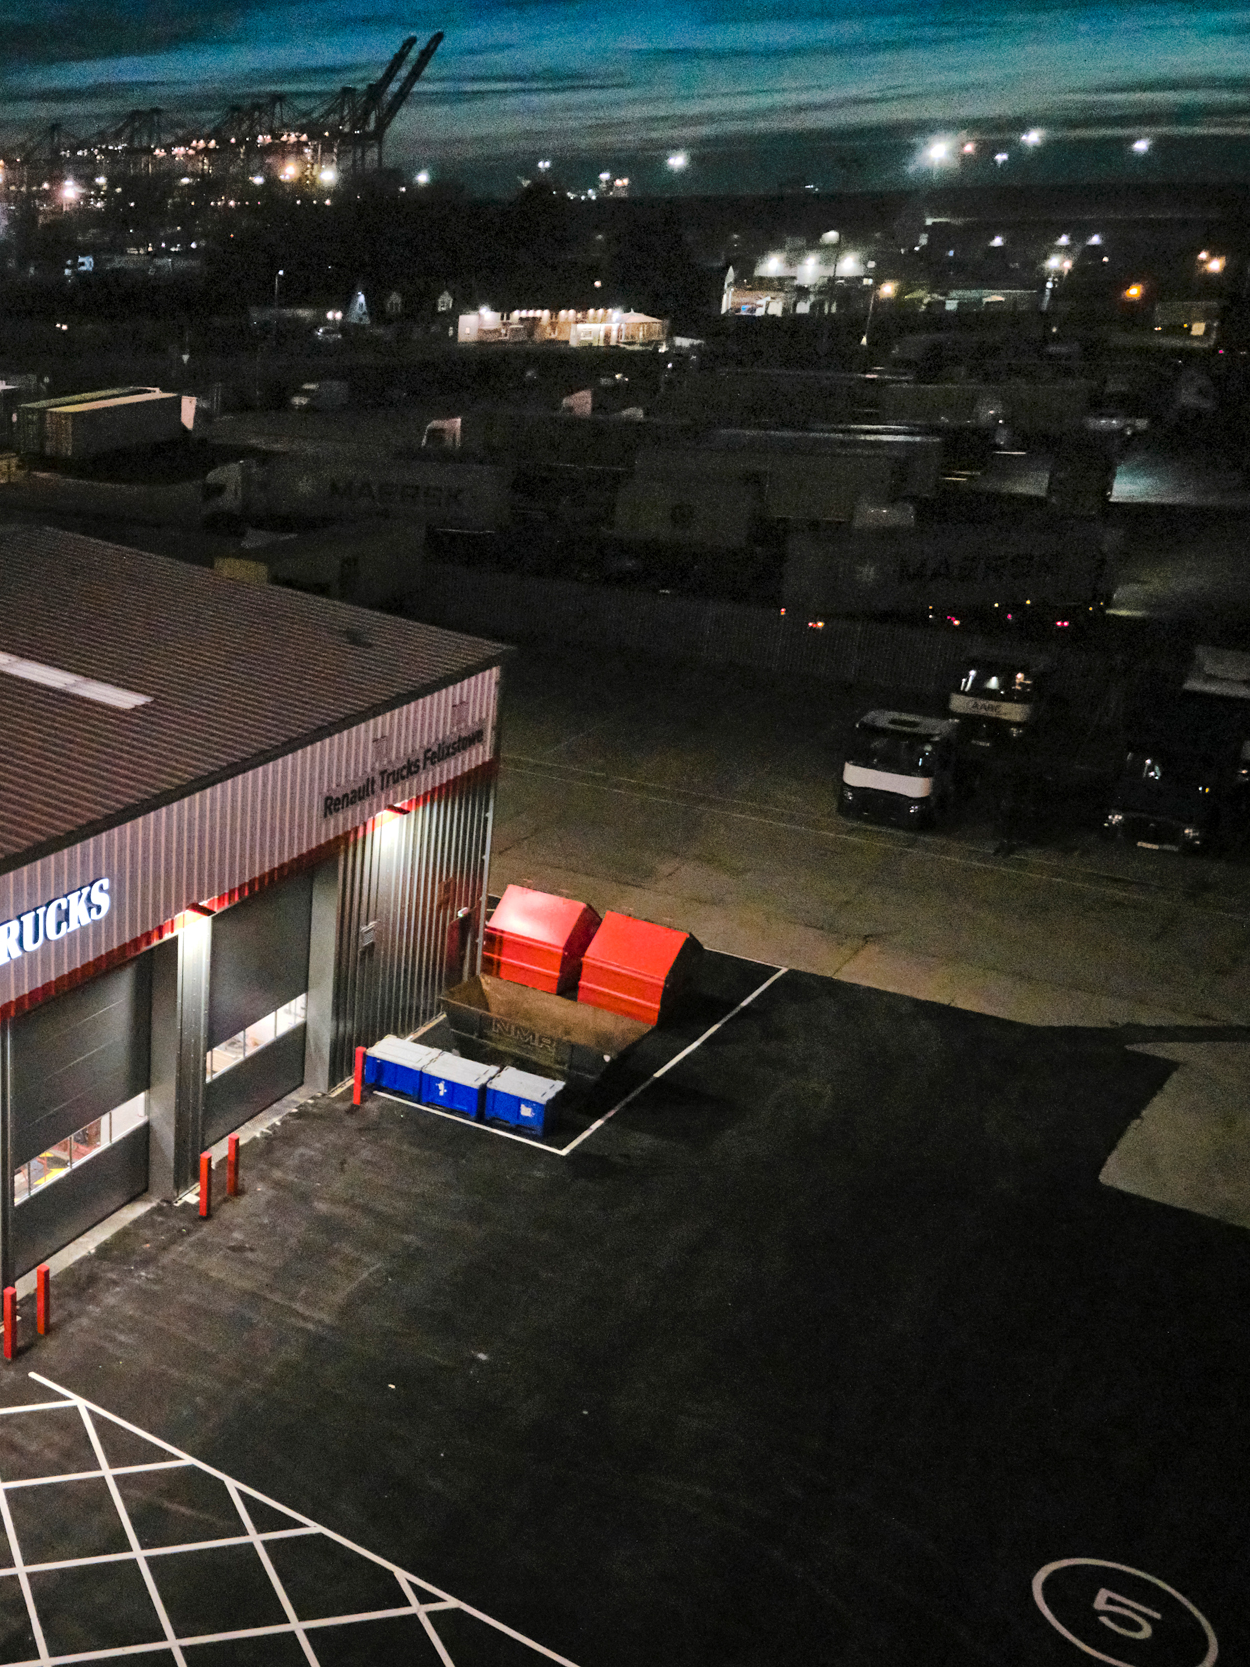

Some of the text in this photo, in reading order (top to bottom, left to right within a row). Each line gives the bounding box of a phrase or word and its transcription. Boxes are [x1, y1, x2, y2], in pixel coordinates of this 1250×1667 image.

[330, 479, 465, 507] MAERSK
[323, 729, 484, 818] Renault Trucks Felixstowe
[1093, 1587, 1162, 1640] 5
